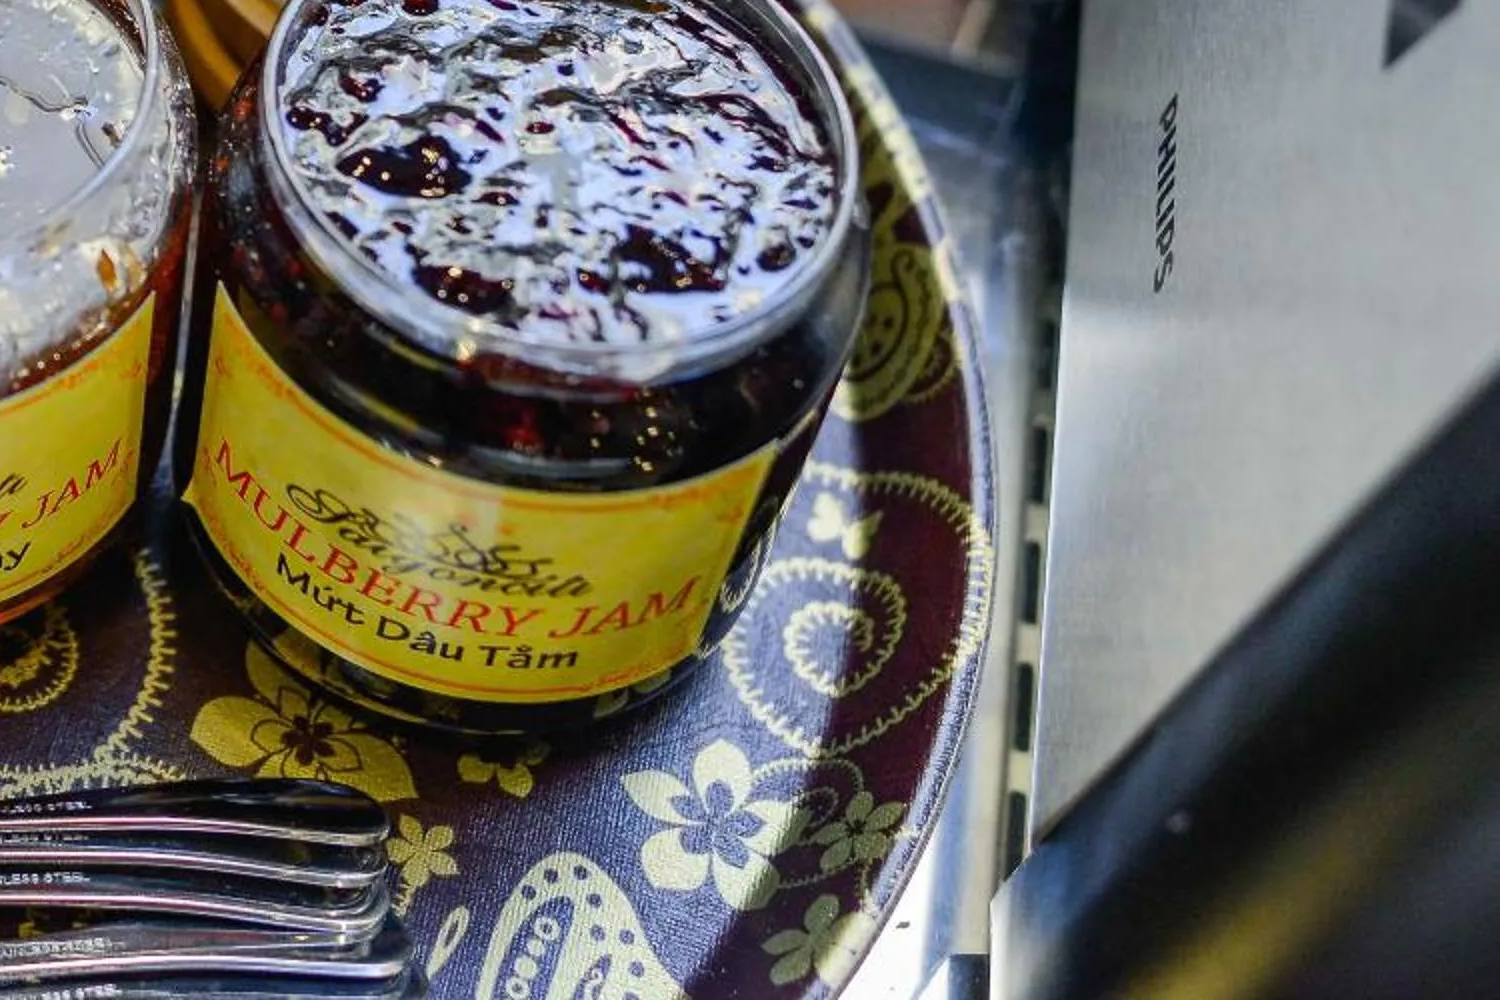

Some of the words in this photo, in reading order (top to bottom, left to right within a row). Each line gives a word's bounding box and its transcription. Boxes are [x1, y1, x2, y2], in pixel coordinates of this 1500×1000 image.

[1153, 92, 1179, 295] PHILIPS
[20, 438, 123, 532] JAM
[214, 437, 548, 638] MULBERRY
[546, 573, 702, 640] JAM
[275, 551, 365, 626] Mứt
[375, 615, 465, 663] Dâu
[43, 871, 91, 885] STEEL
